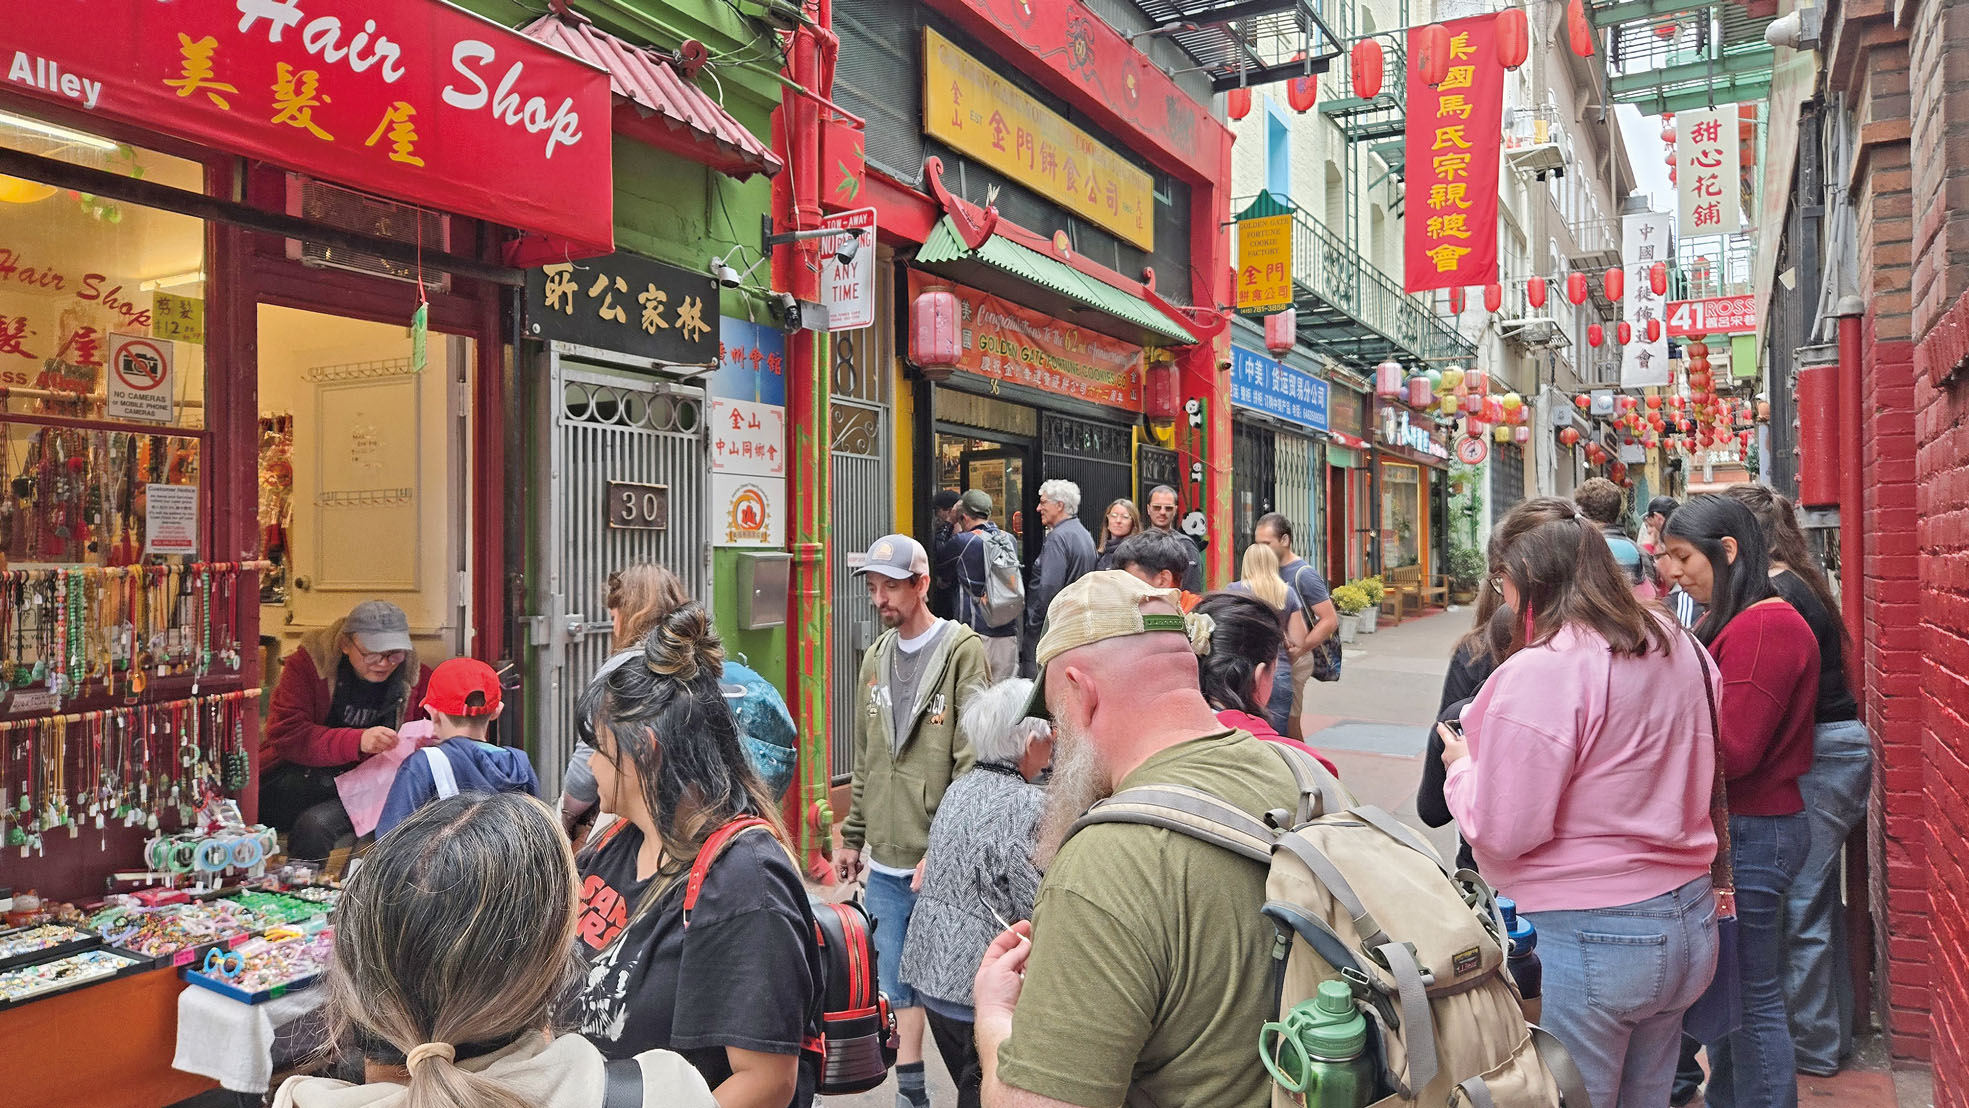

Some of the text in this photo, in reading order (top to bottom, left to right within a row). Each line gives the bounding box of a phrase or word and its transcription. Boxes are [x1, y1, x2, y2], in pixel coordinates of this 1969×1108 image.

[8, 51, 102, 109] Alley
[237, 0, 582, 159] Hair Shop
[163, 32, 426, 168] 美髮屋
[1239, 217, 1289, 230] GOLDEN GATE
[1246, 228, 1281, 238] FORTUNE
[1248, 248, 1279, 257] FACTORY
[1250, 239, 1278, 247] COOKIE
[834, 261, 858, 282] ANY
[1242, 262, 1285, 286] 金門
[0, 249, 152, 327] Hair Shop
[832, 283, 860, 303] TIME
[976, 304, 1042, 340] Congratulations
[1670, 298, 1755, 330] 41 ROSS
[978, 333, 1127, 389] GOLDEN GATE FORTUNE COOKIES CO
[114, 391, 166, 402] NO CAMERAS
[120, 400, 144, 408] MOBILE
[146, 402, 168, 410] PHONE
[124, 408, 155, 417] CAMERAS
[729, 407, 761, 430] 金山
[621, 491, 658, 521] 30
